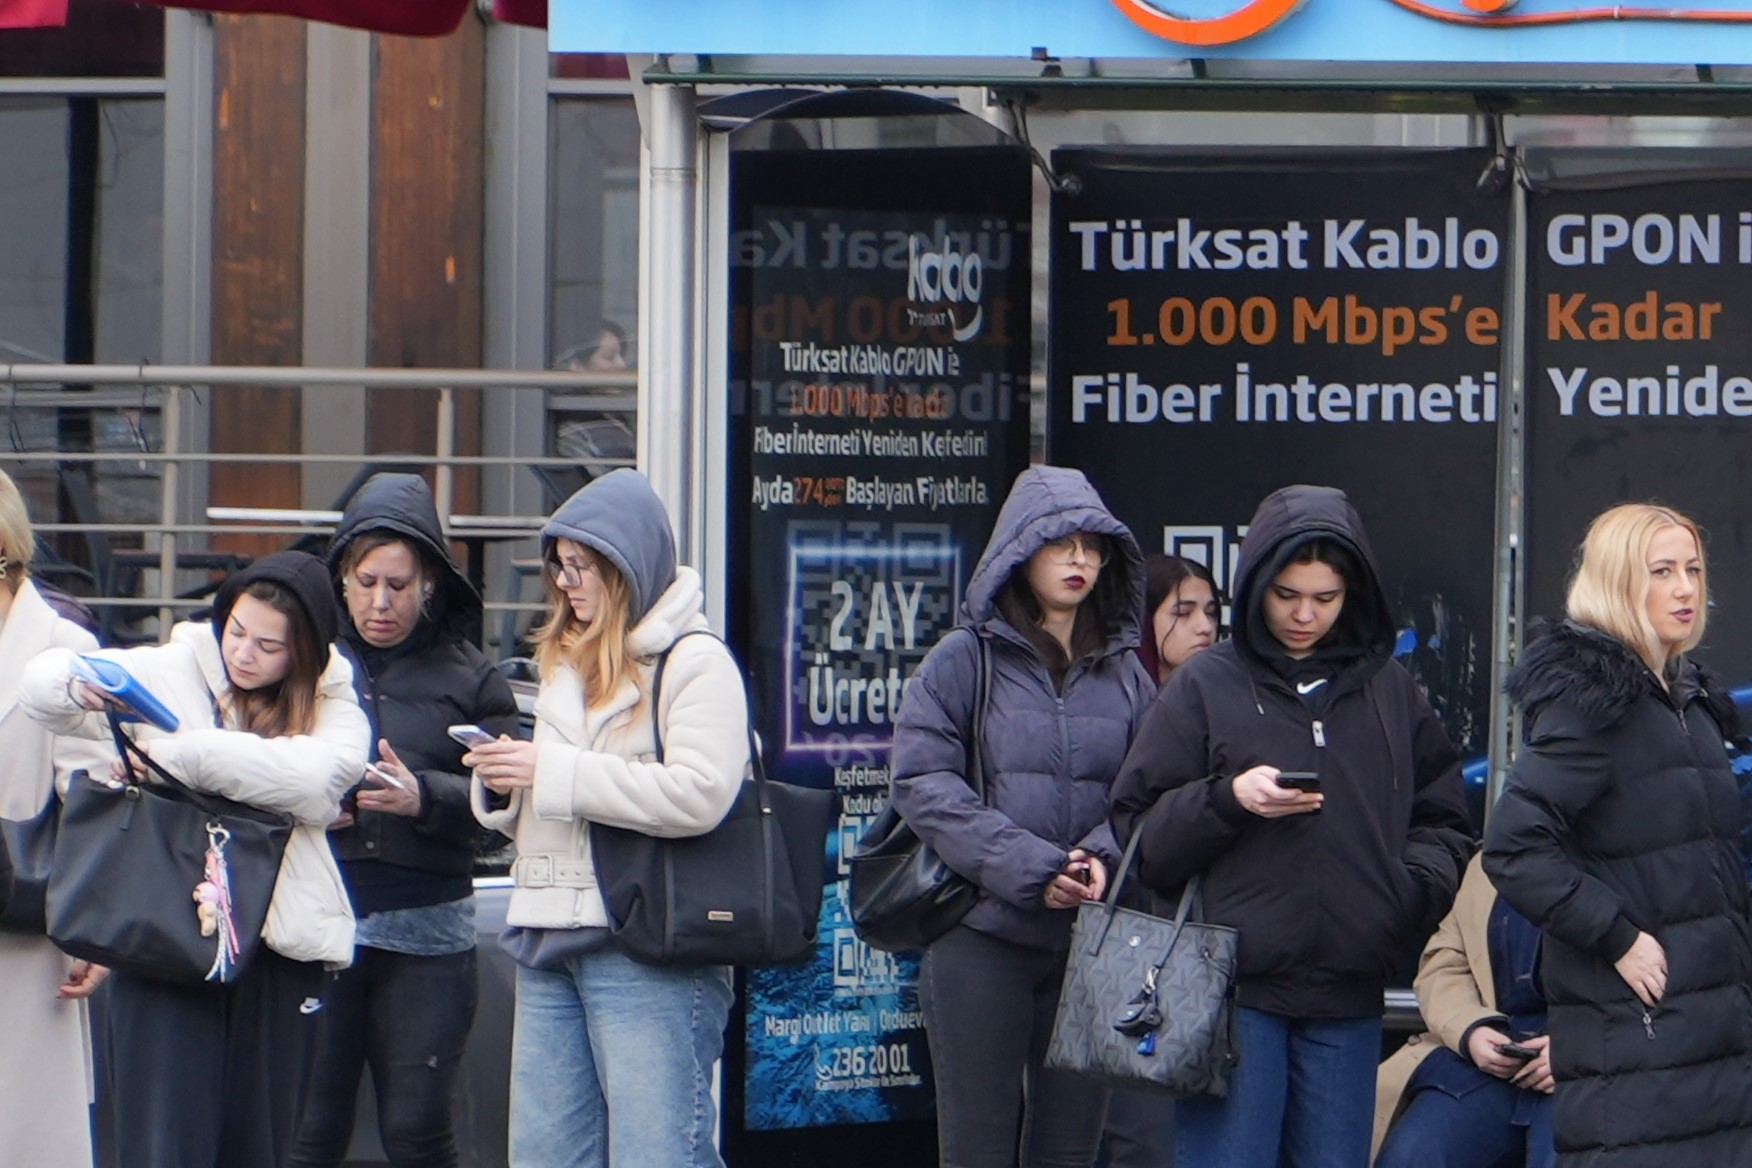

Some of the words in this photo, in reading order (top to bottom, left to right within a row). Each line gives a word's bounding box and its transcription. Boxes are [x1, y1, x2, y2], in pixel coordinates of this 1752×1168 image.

[1068, 218, 1308, 271] Türksat
[1324, 217, 1500, 270] Kablo
[1546, 213, 1720, 266] GPON
[1106, 296, 1277, 346] 1.000
[1292, 294, 1499, 356] Mbps’e
[1546, 290, 1722, 341] Kadar
[780, 341, 848, 374] Türksat
[850, 345, 891, 376] Kablo
[893, 346, 944, 376] GPON
[1071, 372, 1222, 424] Fiber
[1235, 362, 1498, 424] İnterneti
[862, 429, 919, 457] Yeniden
[921, 430, 988, 458] Kefedin!
[752, 475, 793, 511] Ayda
[846, 476, 915, 512] Başlayan
[829, 580, 854, 652] 2
[864, 580, 926, 651] AY
[808, 653, 910, 726] Ücret
[832, 1045, 866, 1077] 236
[868, 1044, 887, 1075] 20
[888, 1042, 912, 1074] 01
